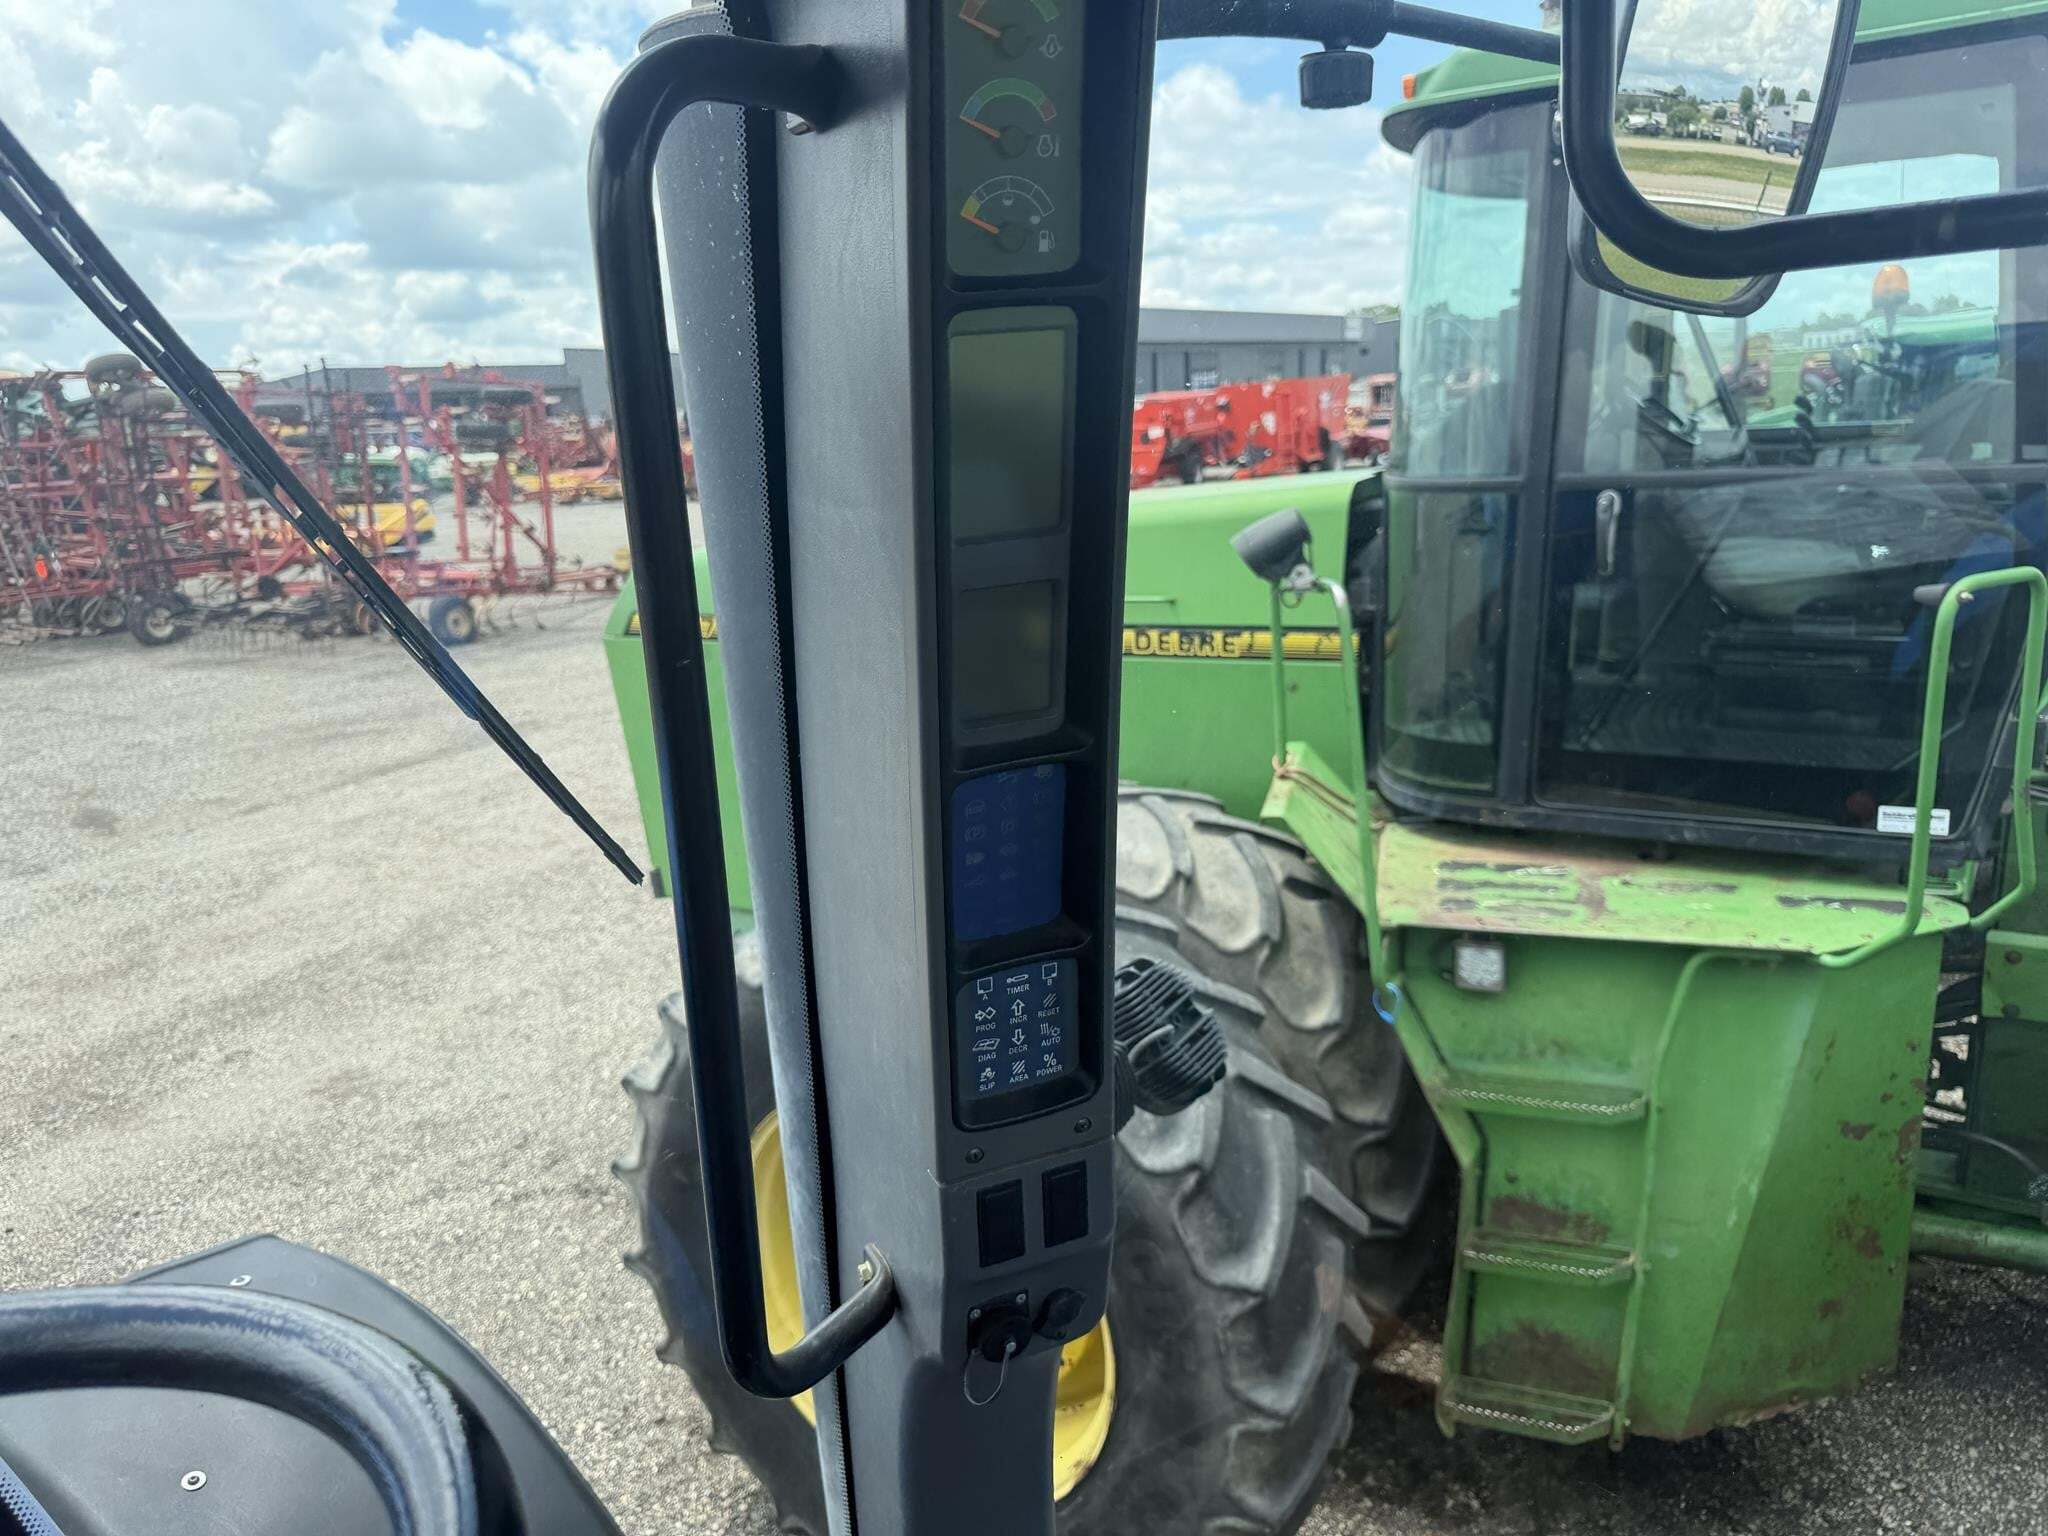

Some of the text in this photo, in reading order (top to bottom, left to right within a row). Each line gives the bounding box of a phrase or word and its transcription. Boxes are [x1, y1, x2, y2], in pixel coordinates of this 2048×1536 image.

[1134, 630, 1239, 656] DEERE
[1006, 984, 1030, 995] TIMER
[982, 993, 989, 1001] A
[1038, 1007, 1060, 1018] RESET
[1009, 1014, 1028, 1025] INCR
[975, 1022, 996, 1033] PROG
[1041, 1036, 1061, 1047] AUTO
[1008, 1044, 1028, 1055] DECR
[978, 1052, 997, 1063] DIAG
[1036, 1064, 1063, 1078] POWER
[1009, 1073, 1029, 1084] AREA
[979, 1081, 996, 1092] SLIP
